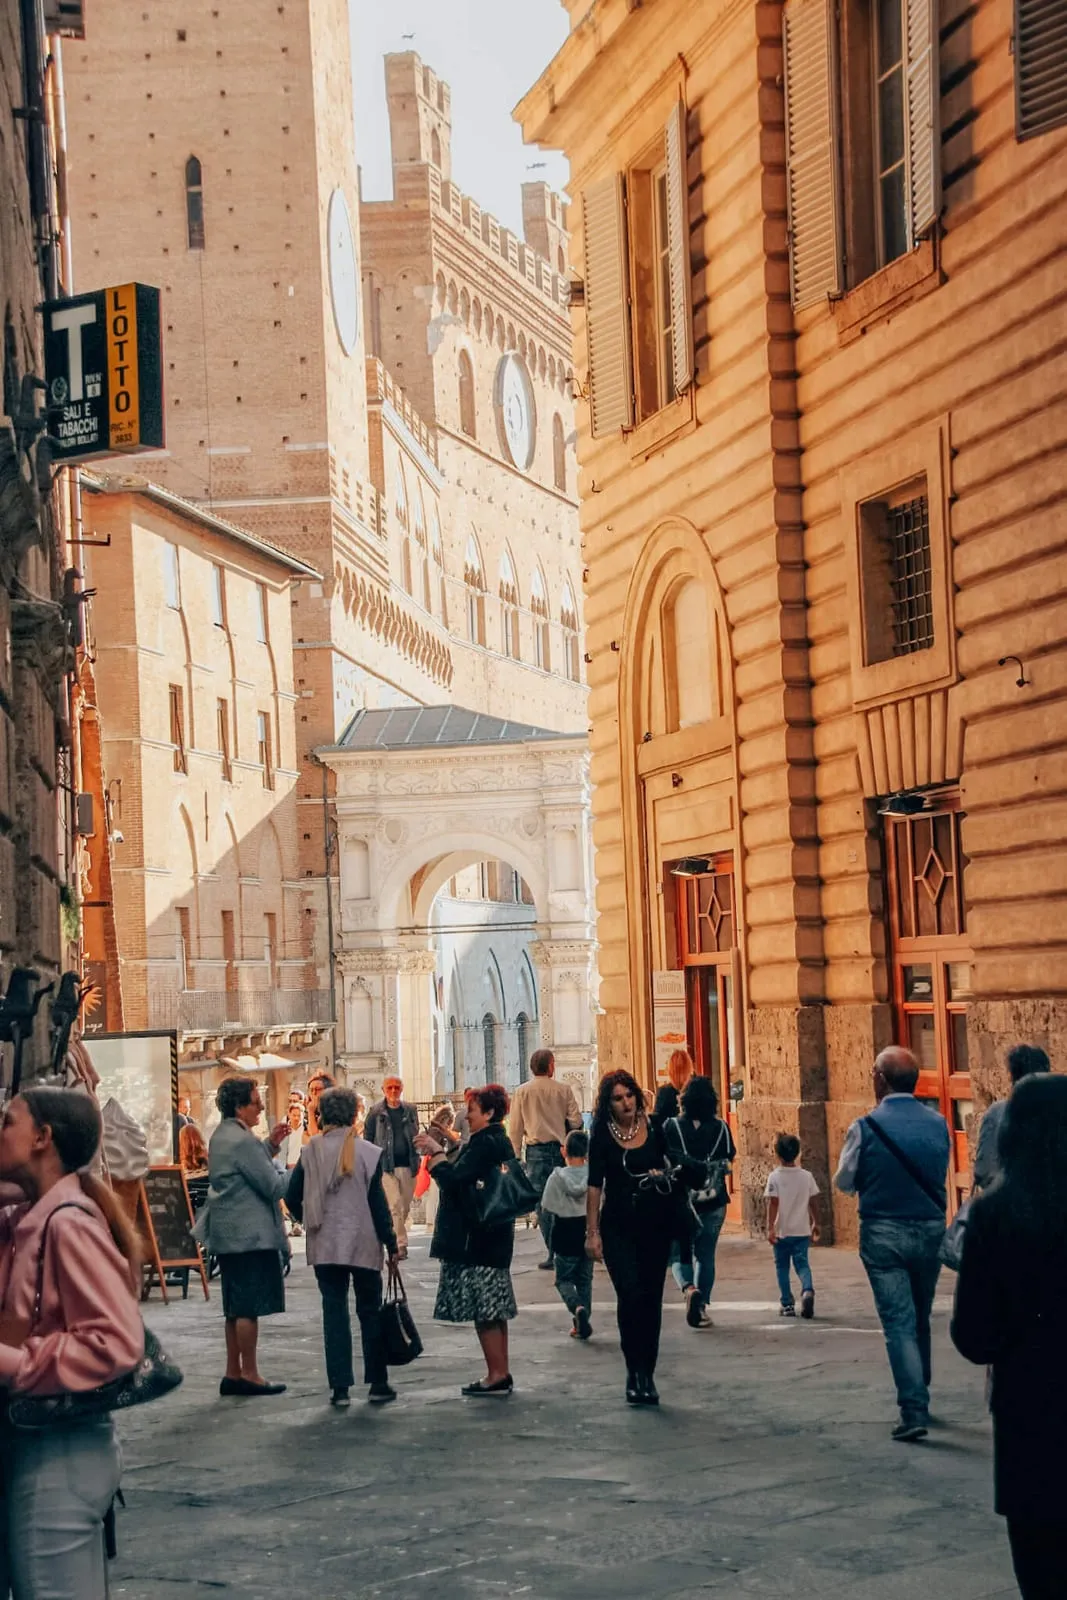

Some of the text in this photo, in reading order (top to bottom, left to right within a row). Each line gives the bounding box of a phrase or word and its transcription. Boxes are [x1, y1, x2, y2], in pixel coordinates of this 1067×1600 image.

[51, 304, 97, 402] T
[112, 291, 131, 413] LOTTO
[58, 416, 98, 438] TABACCHI
[63, 402, 91, 421] SALI E
